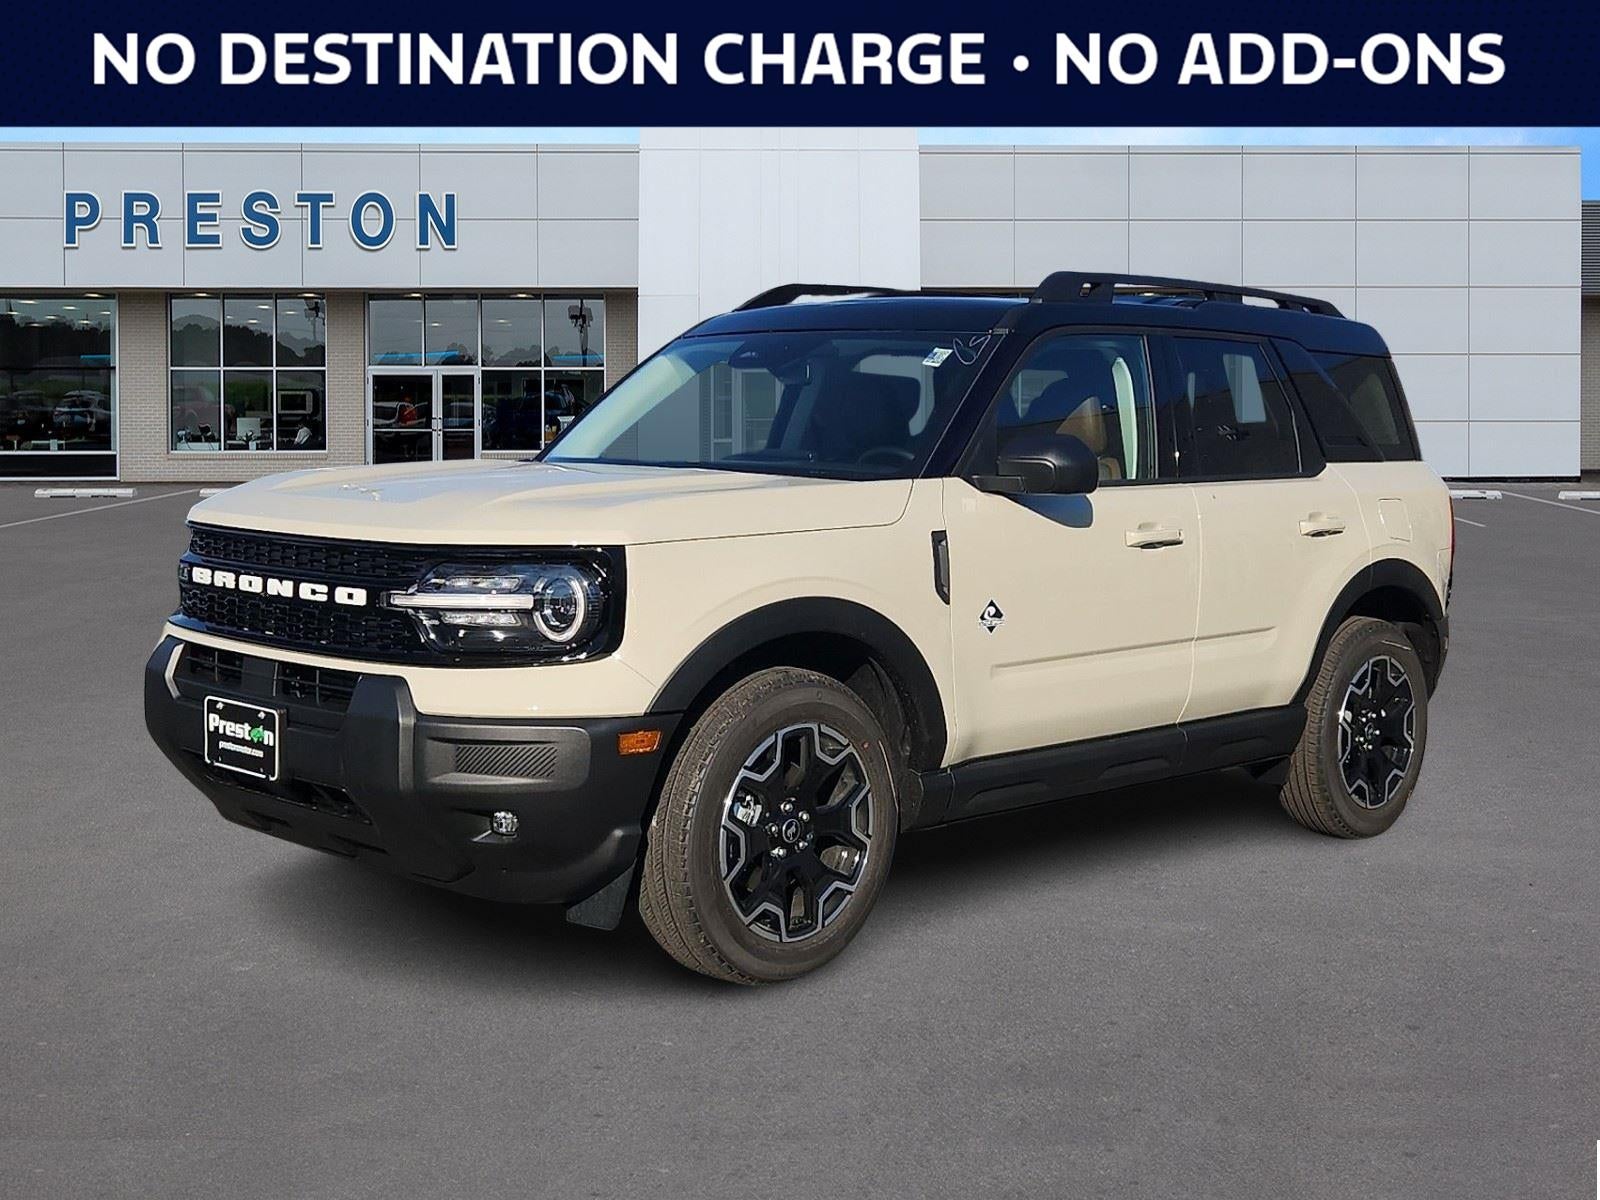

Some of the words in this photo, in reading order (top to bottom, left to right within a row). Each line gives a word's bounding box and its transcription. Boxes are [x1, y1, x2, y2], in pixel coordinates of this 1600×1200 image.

[63, 190, 458, 250] PRESTON
[192, 566, 368, 607] BRONCO
[208, 712, 275, 747] Preston
